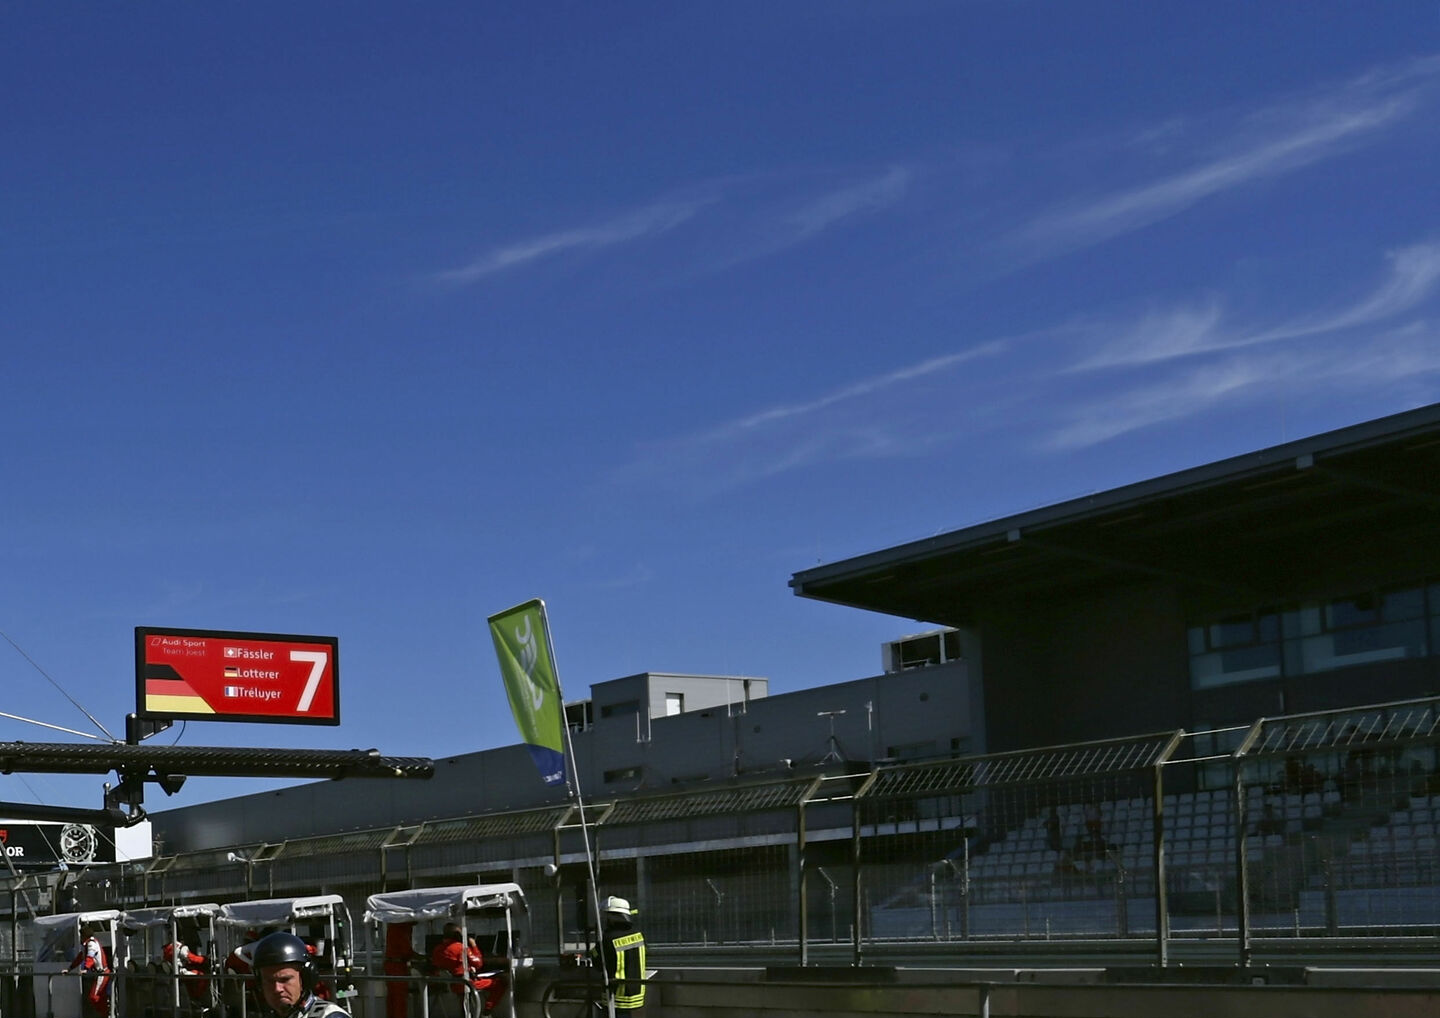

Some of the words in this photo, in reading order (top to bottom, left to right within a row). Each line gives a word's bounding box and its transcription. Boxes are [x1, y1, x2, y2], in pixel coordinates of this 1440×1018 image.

[162, 638, 181, 646] Audi
[182, 639, 206, 648] Sport
[237, 648, 274, 660] Fässler
[238, 668, 279, 680] Lotterer
[289, 650, 328, 712] 7
[238, 686, 281, 701] Tréluyer
